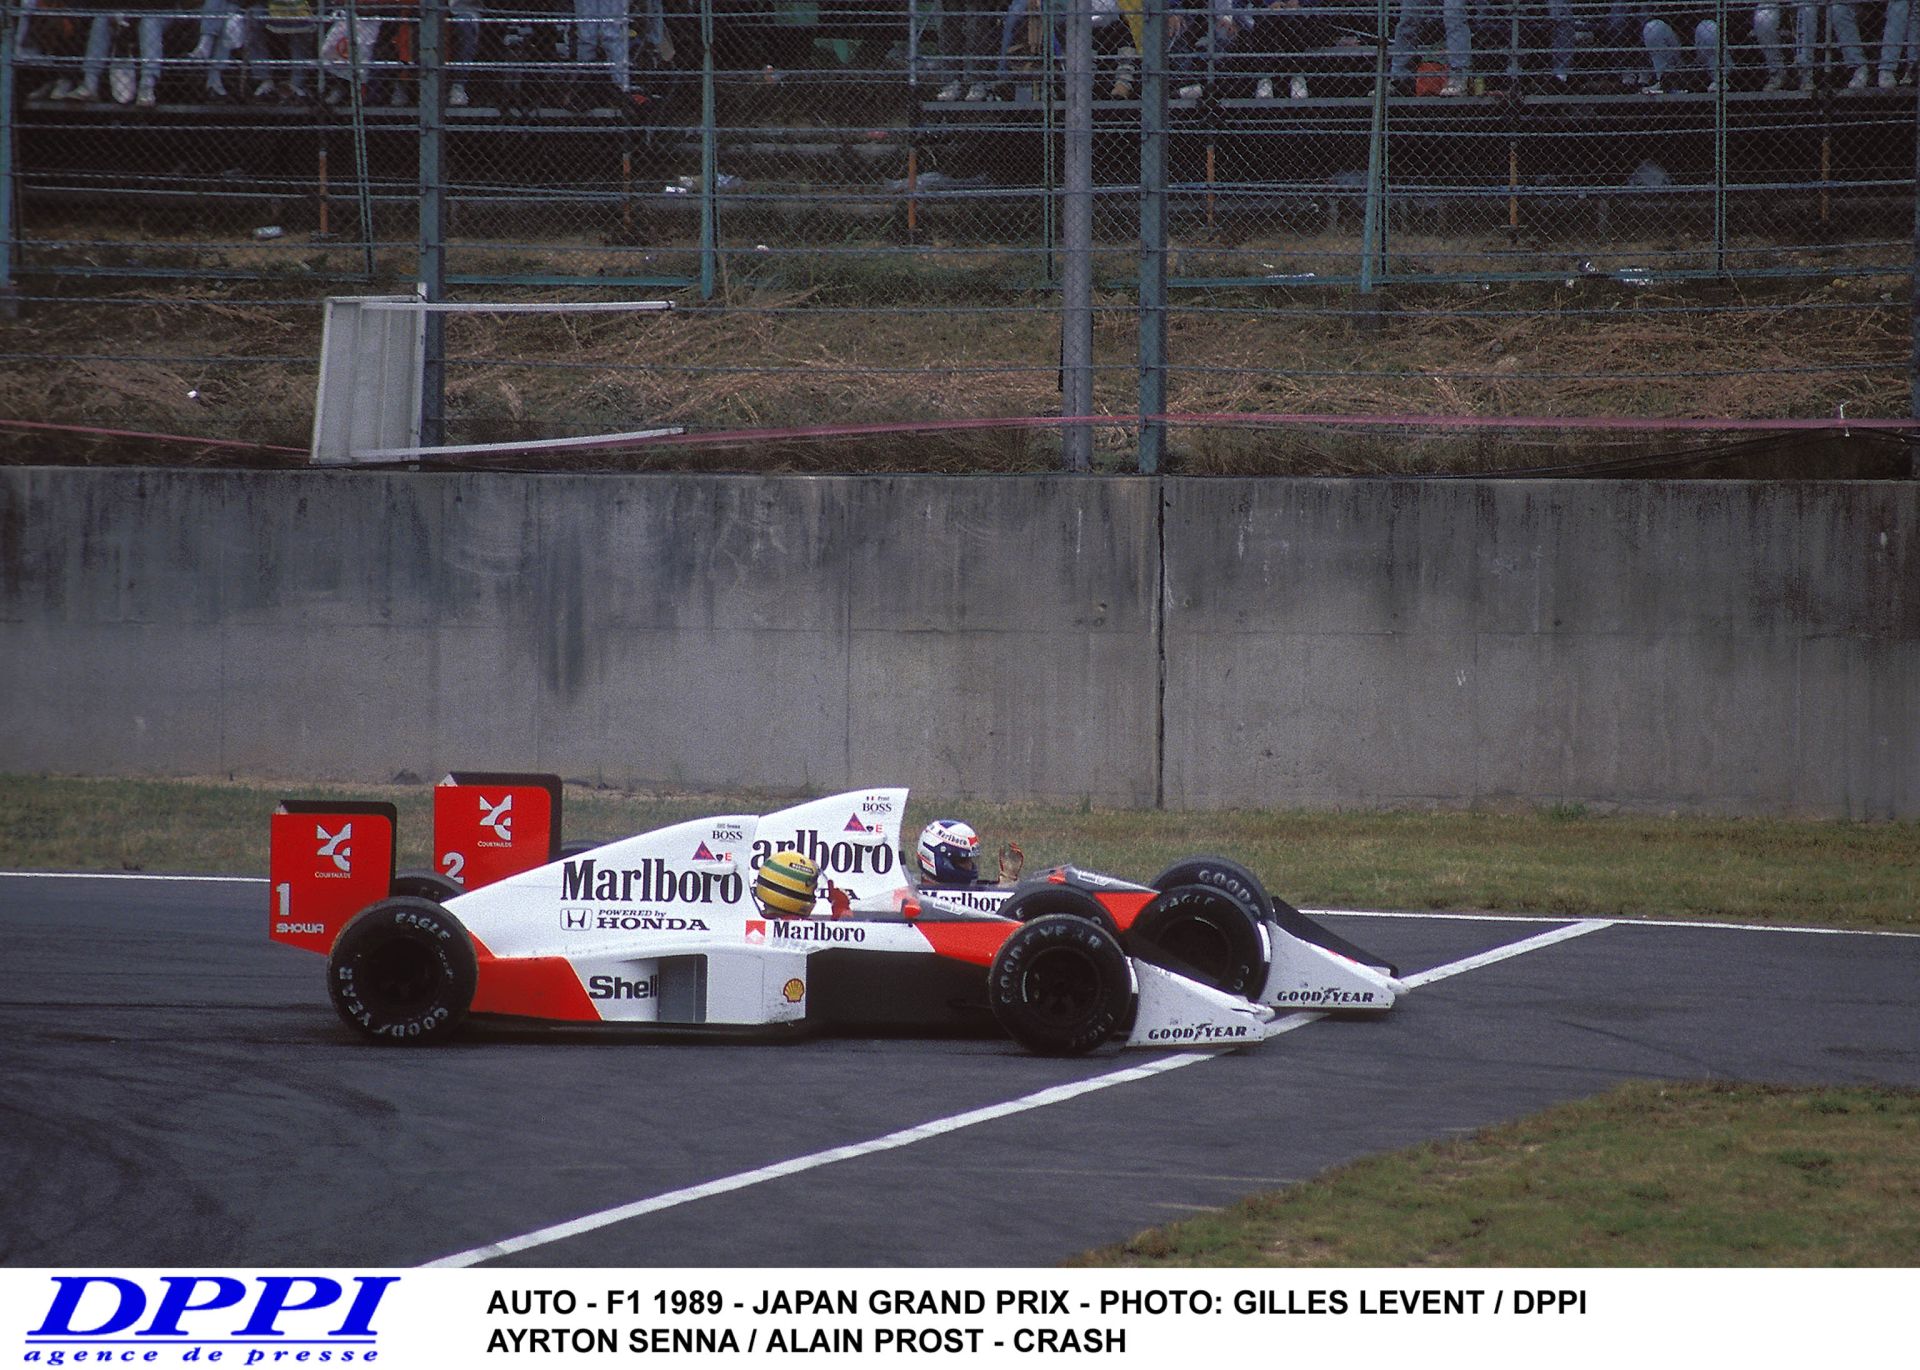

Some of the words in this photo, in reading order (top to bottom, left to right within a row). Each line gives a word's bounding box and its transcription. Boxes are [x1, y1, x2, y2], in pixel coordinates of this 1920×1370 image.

[862, 803, 892, 812] BOSS
[712, 830, 743, 840] BOSS
[937, 829, 968, 847] Marlboro
[751, 829, 894, 875] arlboro
[442, 852, 465, 884] 2
[560, 858, 743, 904] Marlboro
[275, 882, 290, 916] 1
[654, 909, 667, 918] by
[275, 922, 325, 934] SHOWA
[395, 912, 451, 940] EAGLE
[596, 917, 710, 931] HONDA
[773, 921, 866, 943] Marlboro
[589, 975, 658, 1000] Shell
[1277, 988, 1375, 1005] GOODYEAR
[1148, 1024, 1248, 1041] GOODYEAR
